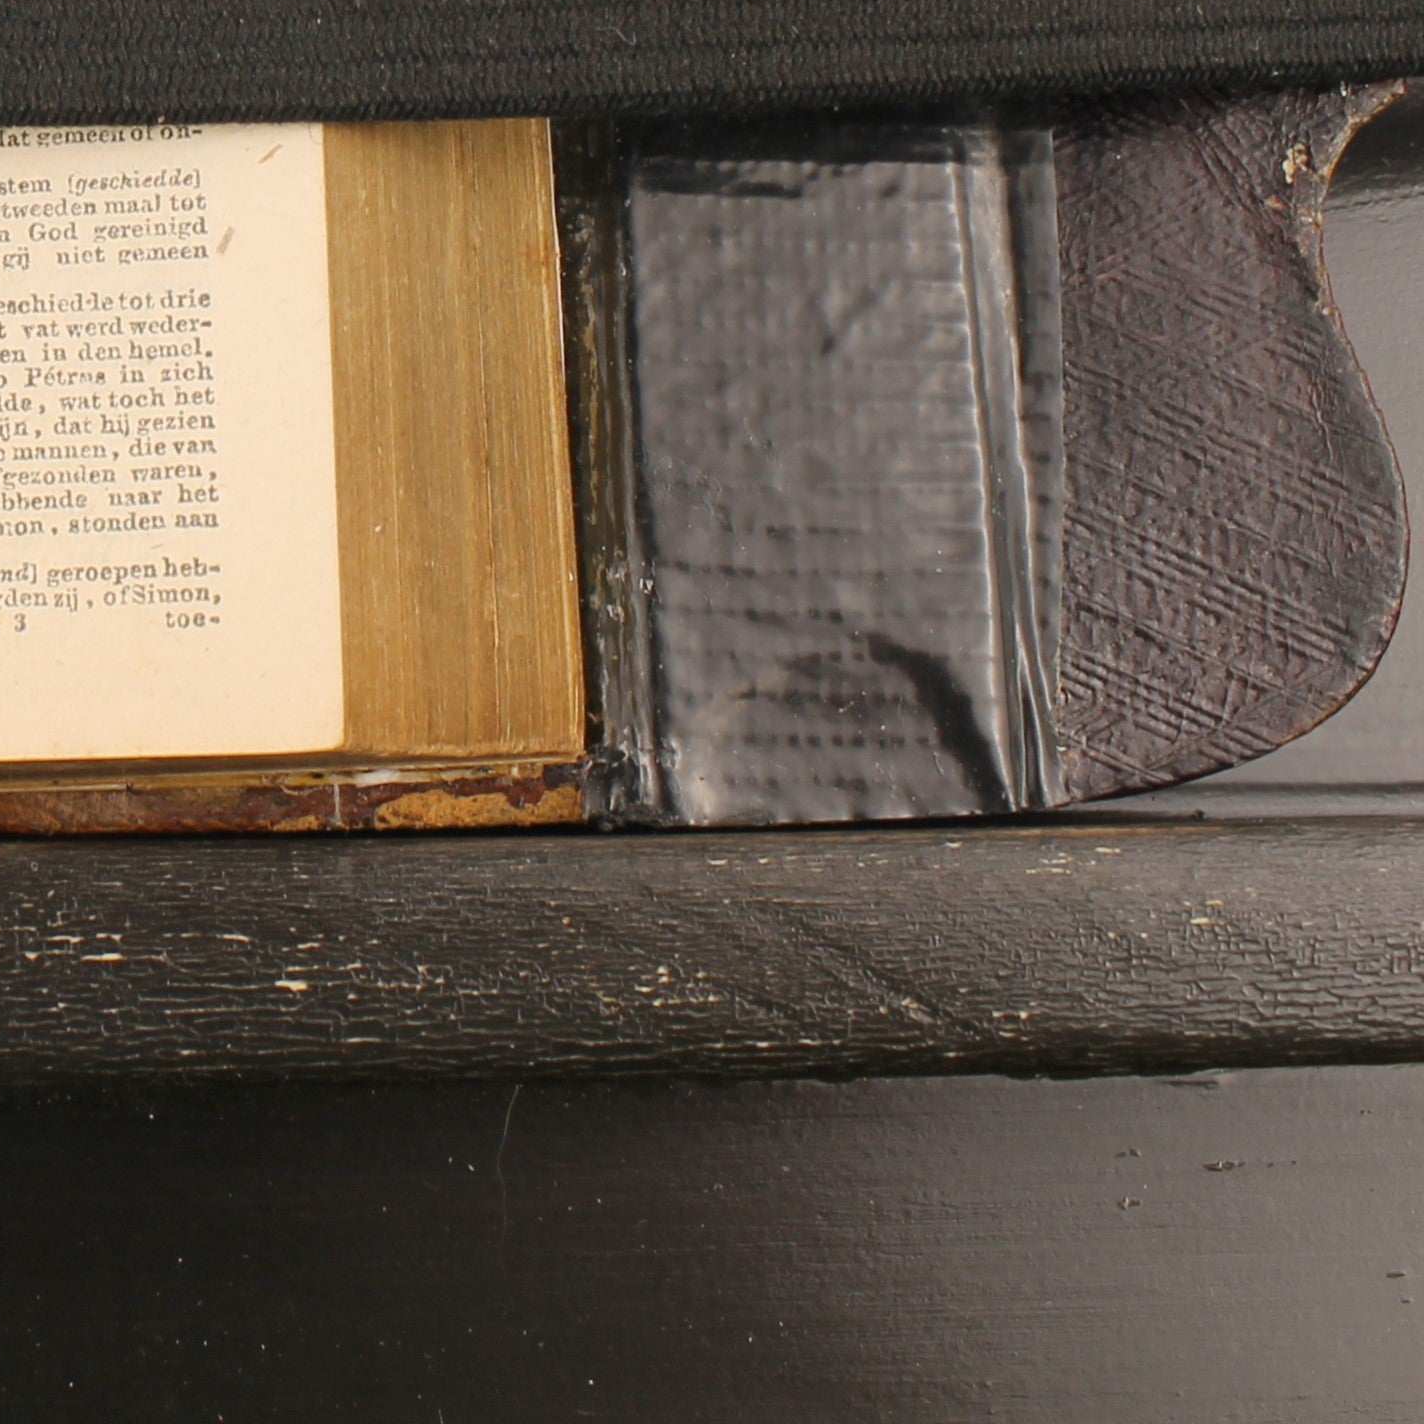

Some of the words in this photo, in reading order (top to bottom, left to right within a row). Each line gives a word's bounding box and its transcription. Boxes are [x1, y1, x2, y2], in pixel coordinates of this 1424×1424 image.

[120, 365, 145, 384] in
[161, 361, 214, 383] zich
[47, 565, 157, 589] geroepen
[14, 613, 26, 632] 3
